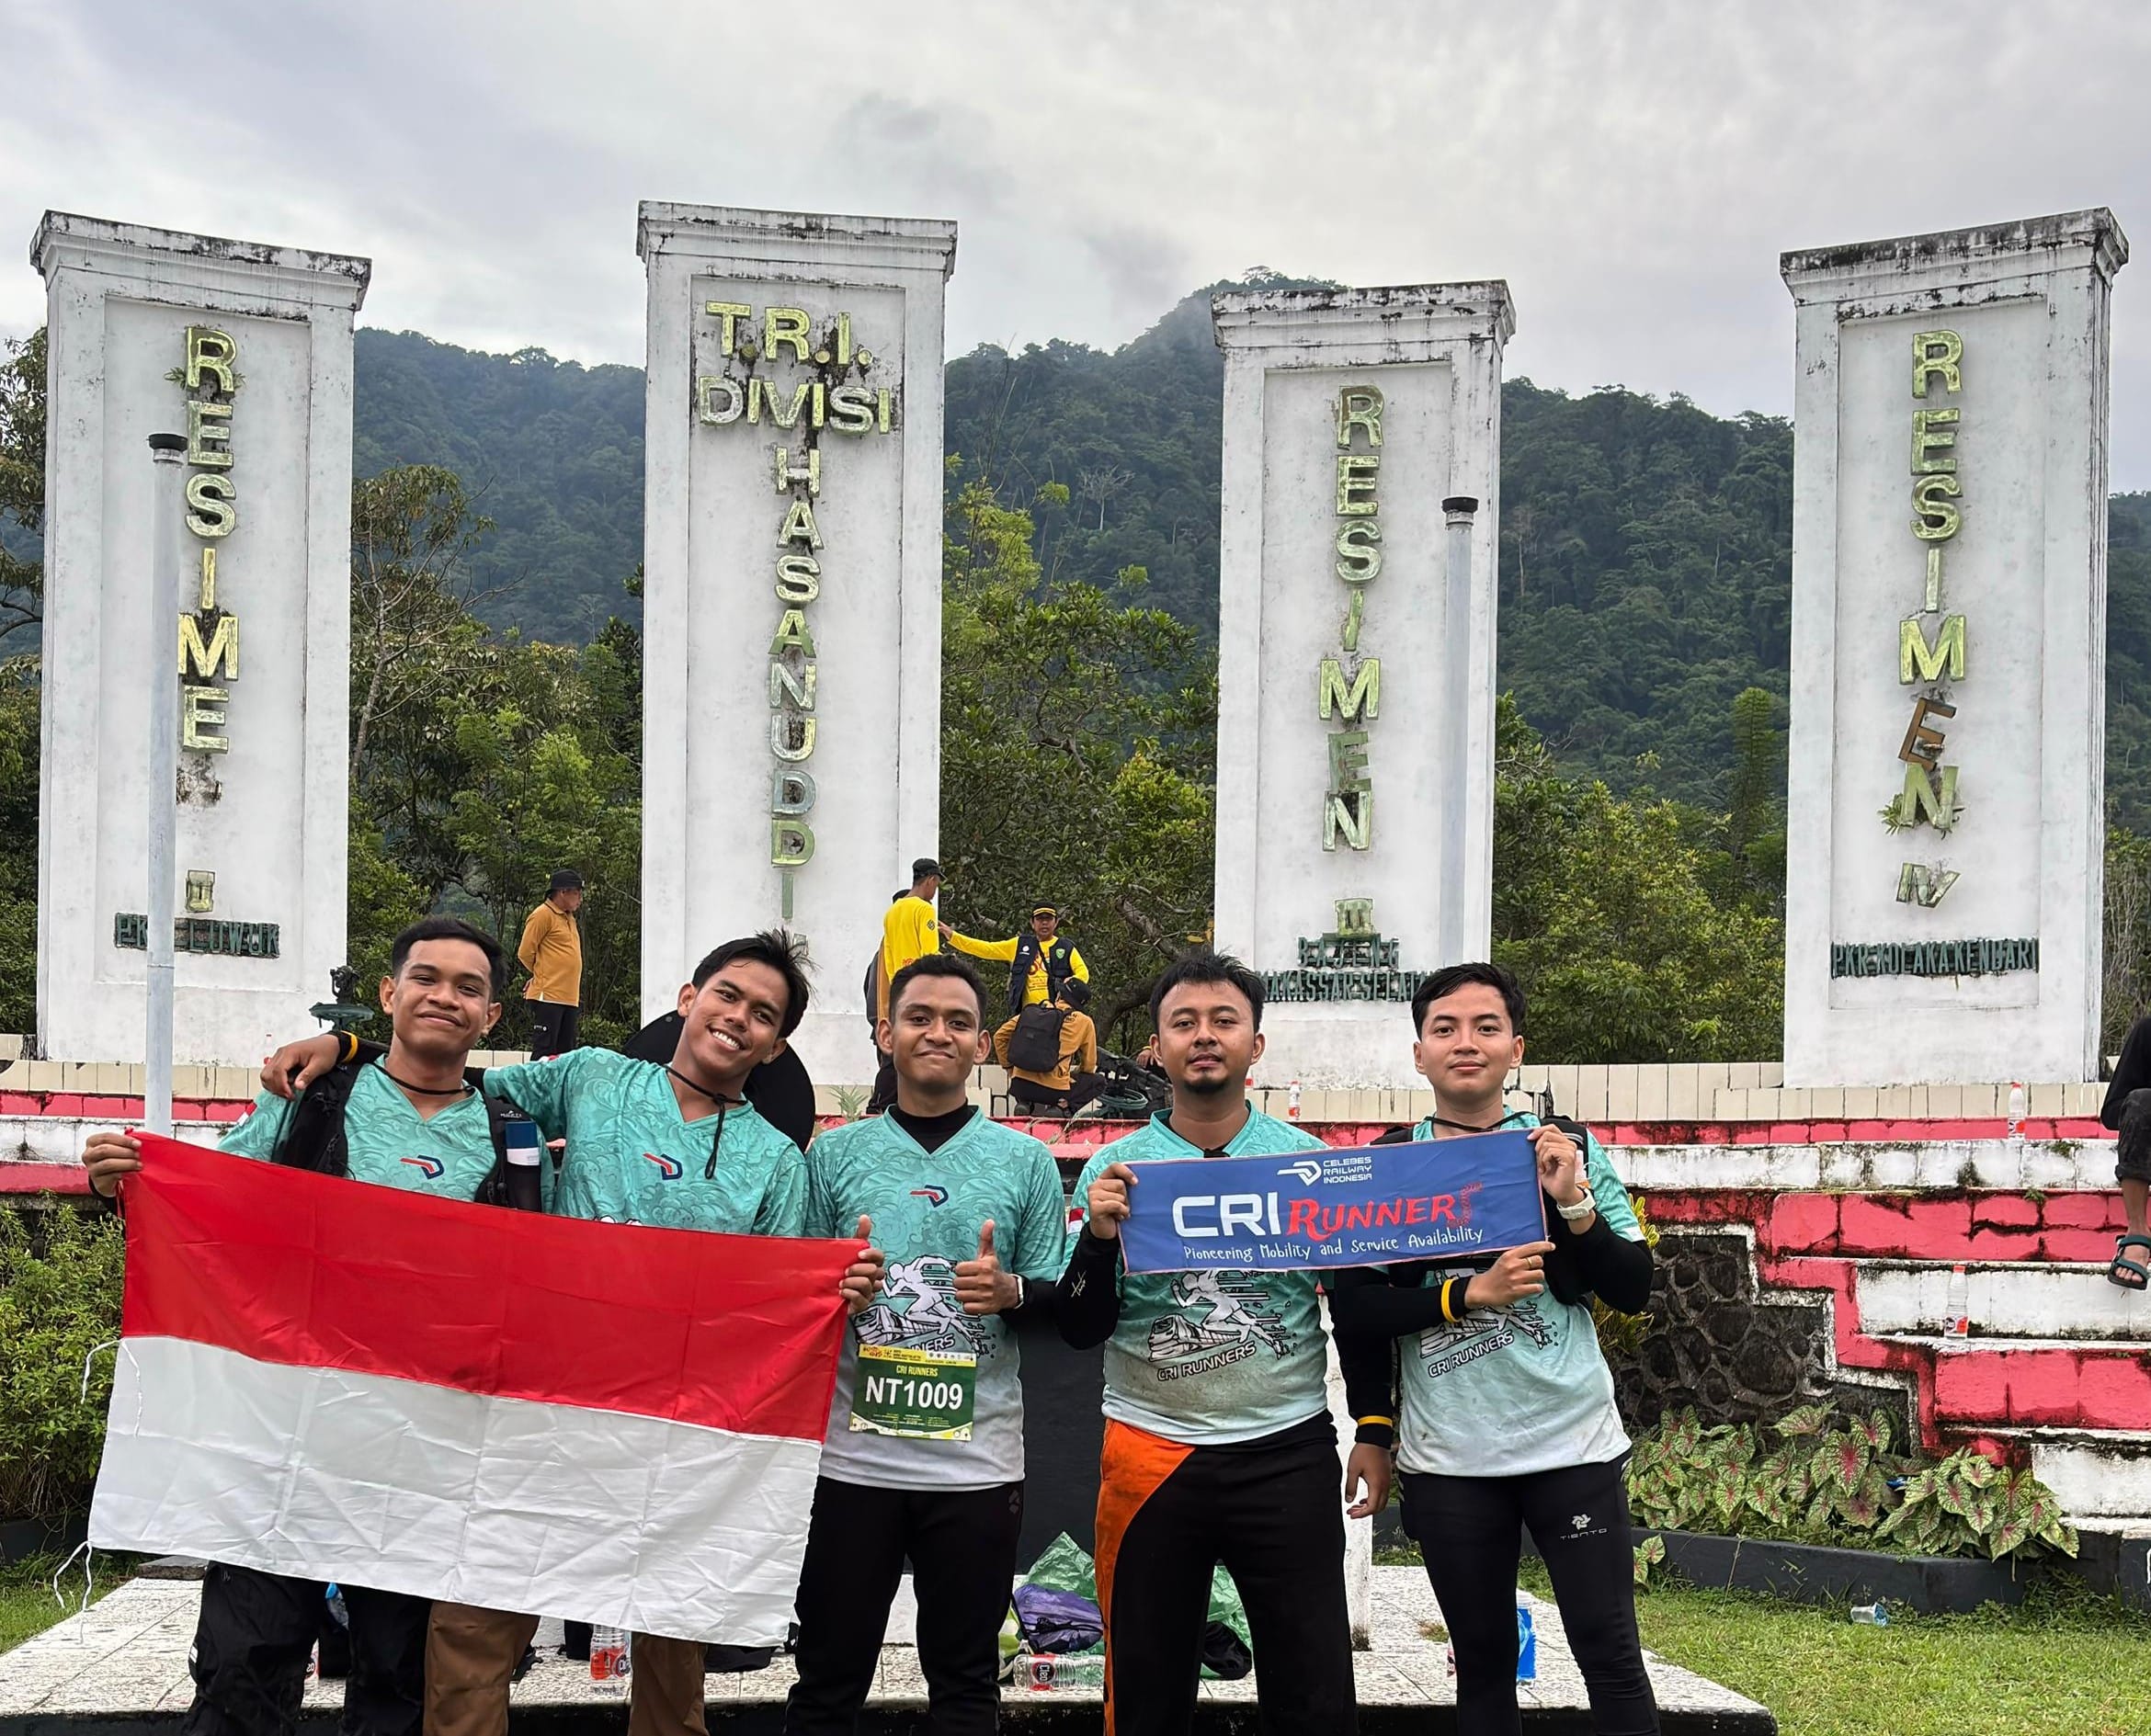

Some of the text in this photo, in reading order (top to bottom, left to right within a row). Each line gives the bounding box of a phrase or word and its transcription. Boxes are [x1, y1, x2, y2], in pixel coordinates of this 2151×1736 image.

[699, 375, 892, 437] DIVISI
[1897, 329, 1967, 834] RESIMEN
[1318, 384, 1384, 853] RESIMEN
[1297, 933, 1400, 969] BAJENG
[1360, 970, 1429, 1002] SELAT
[1323, 1156, 1372, 1168] CELEBES
[1323, 1164, 1372, 1176] RAILWAY
[1323, 1173, 1372, 1185] INDONESIA
[1172, 1191, 1282, 1238] CRI
[1183, 1225, 1484, 1264] Pioneering Mobility and Service Availability
[895, 1364, 939, 1378] CRI RUNNERS
[1156, 1340, 1258, 1382] CRI RUNNERS
[1428, 1331, 1516, 1379] CRI RUNNERS
[864, 1375, 964, 1411] NT1009
